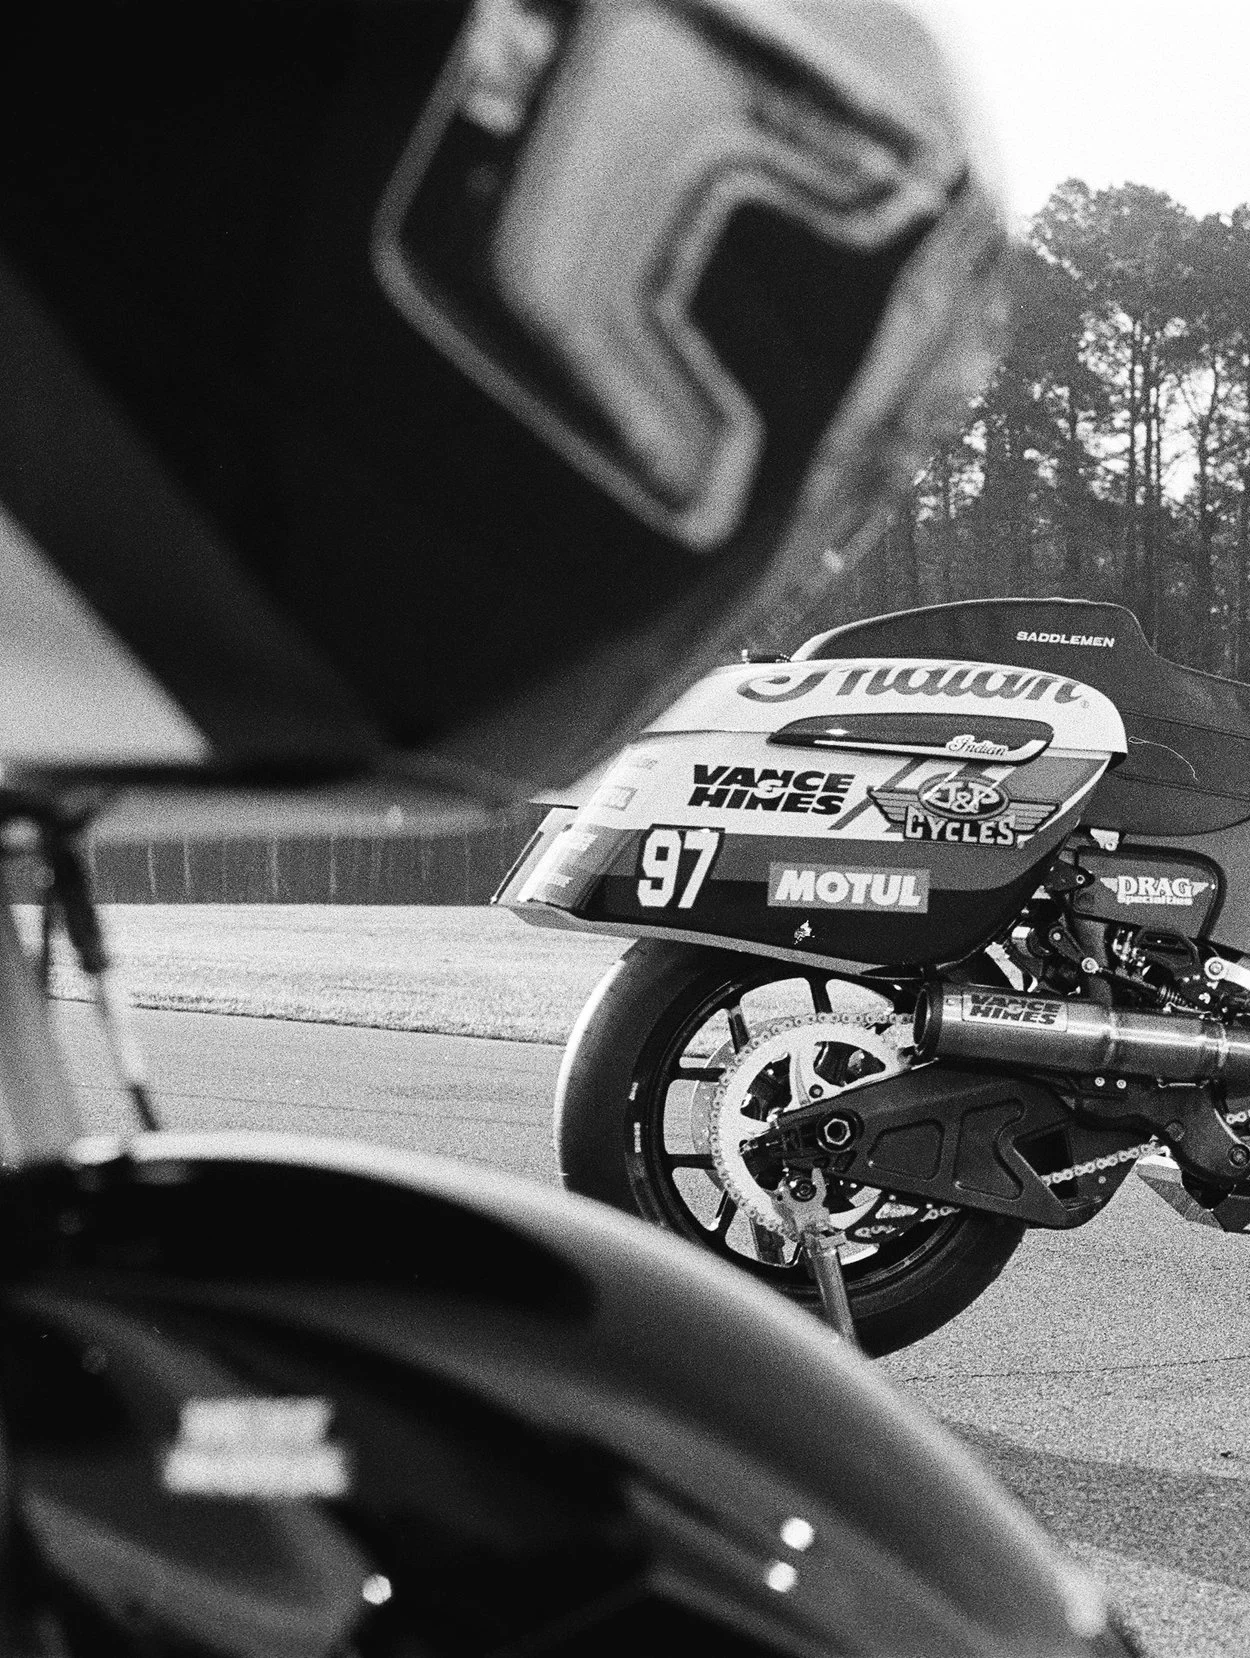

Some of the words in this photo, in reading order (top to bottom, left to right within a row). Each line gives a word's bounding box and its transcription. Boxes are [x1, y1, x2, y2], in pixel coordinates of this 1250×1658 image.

[1016, 631, 1115, 648] SADDLEMEN
[948, 735, 1007, 756] Indian
[694, 764, 856, 793] VANCE
[687, 786, 846, 815] HINES
[905, 806, 1016, 846] CYCLES
[637, 828, 719, 909] 97
[774, 869, 922, 906] MOTUL
[1117, 876, 1193, 897] DRAG
[969, 1005, 1058, 1025] HINES
[970, 993, 1062, 1013] VANCE
